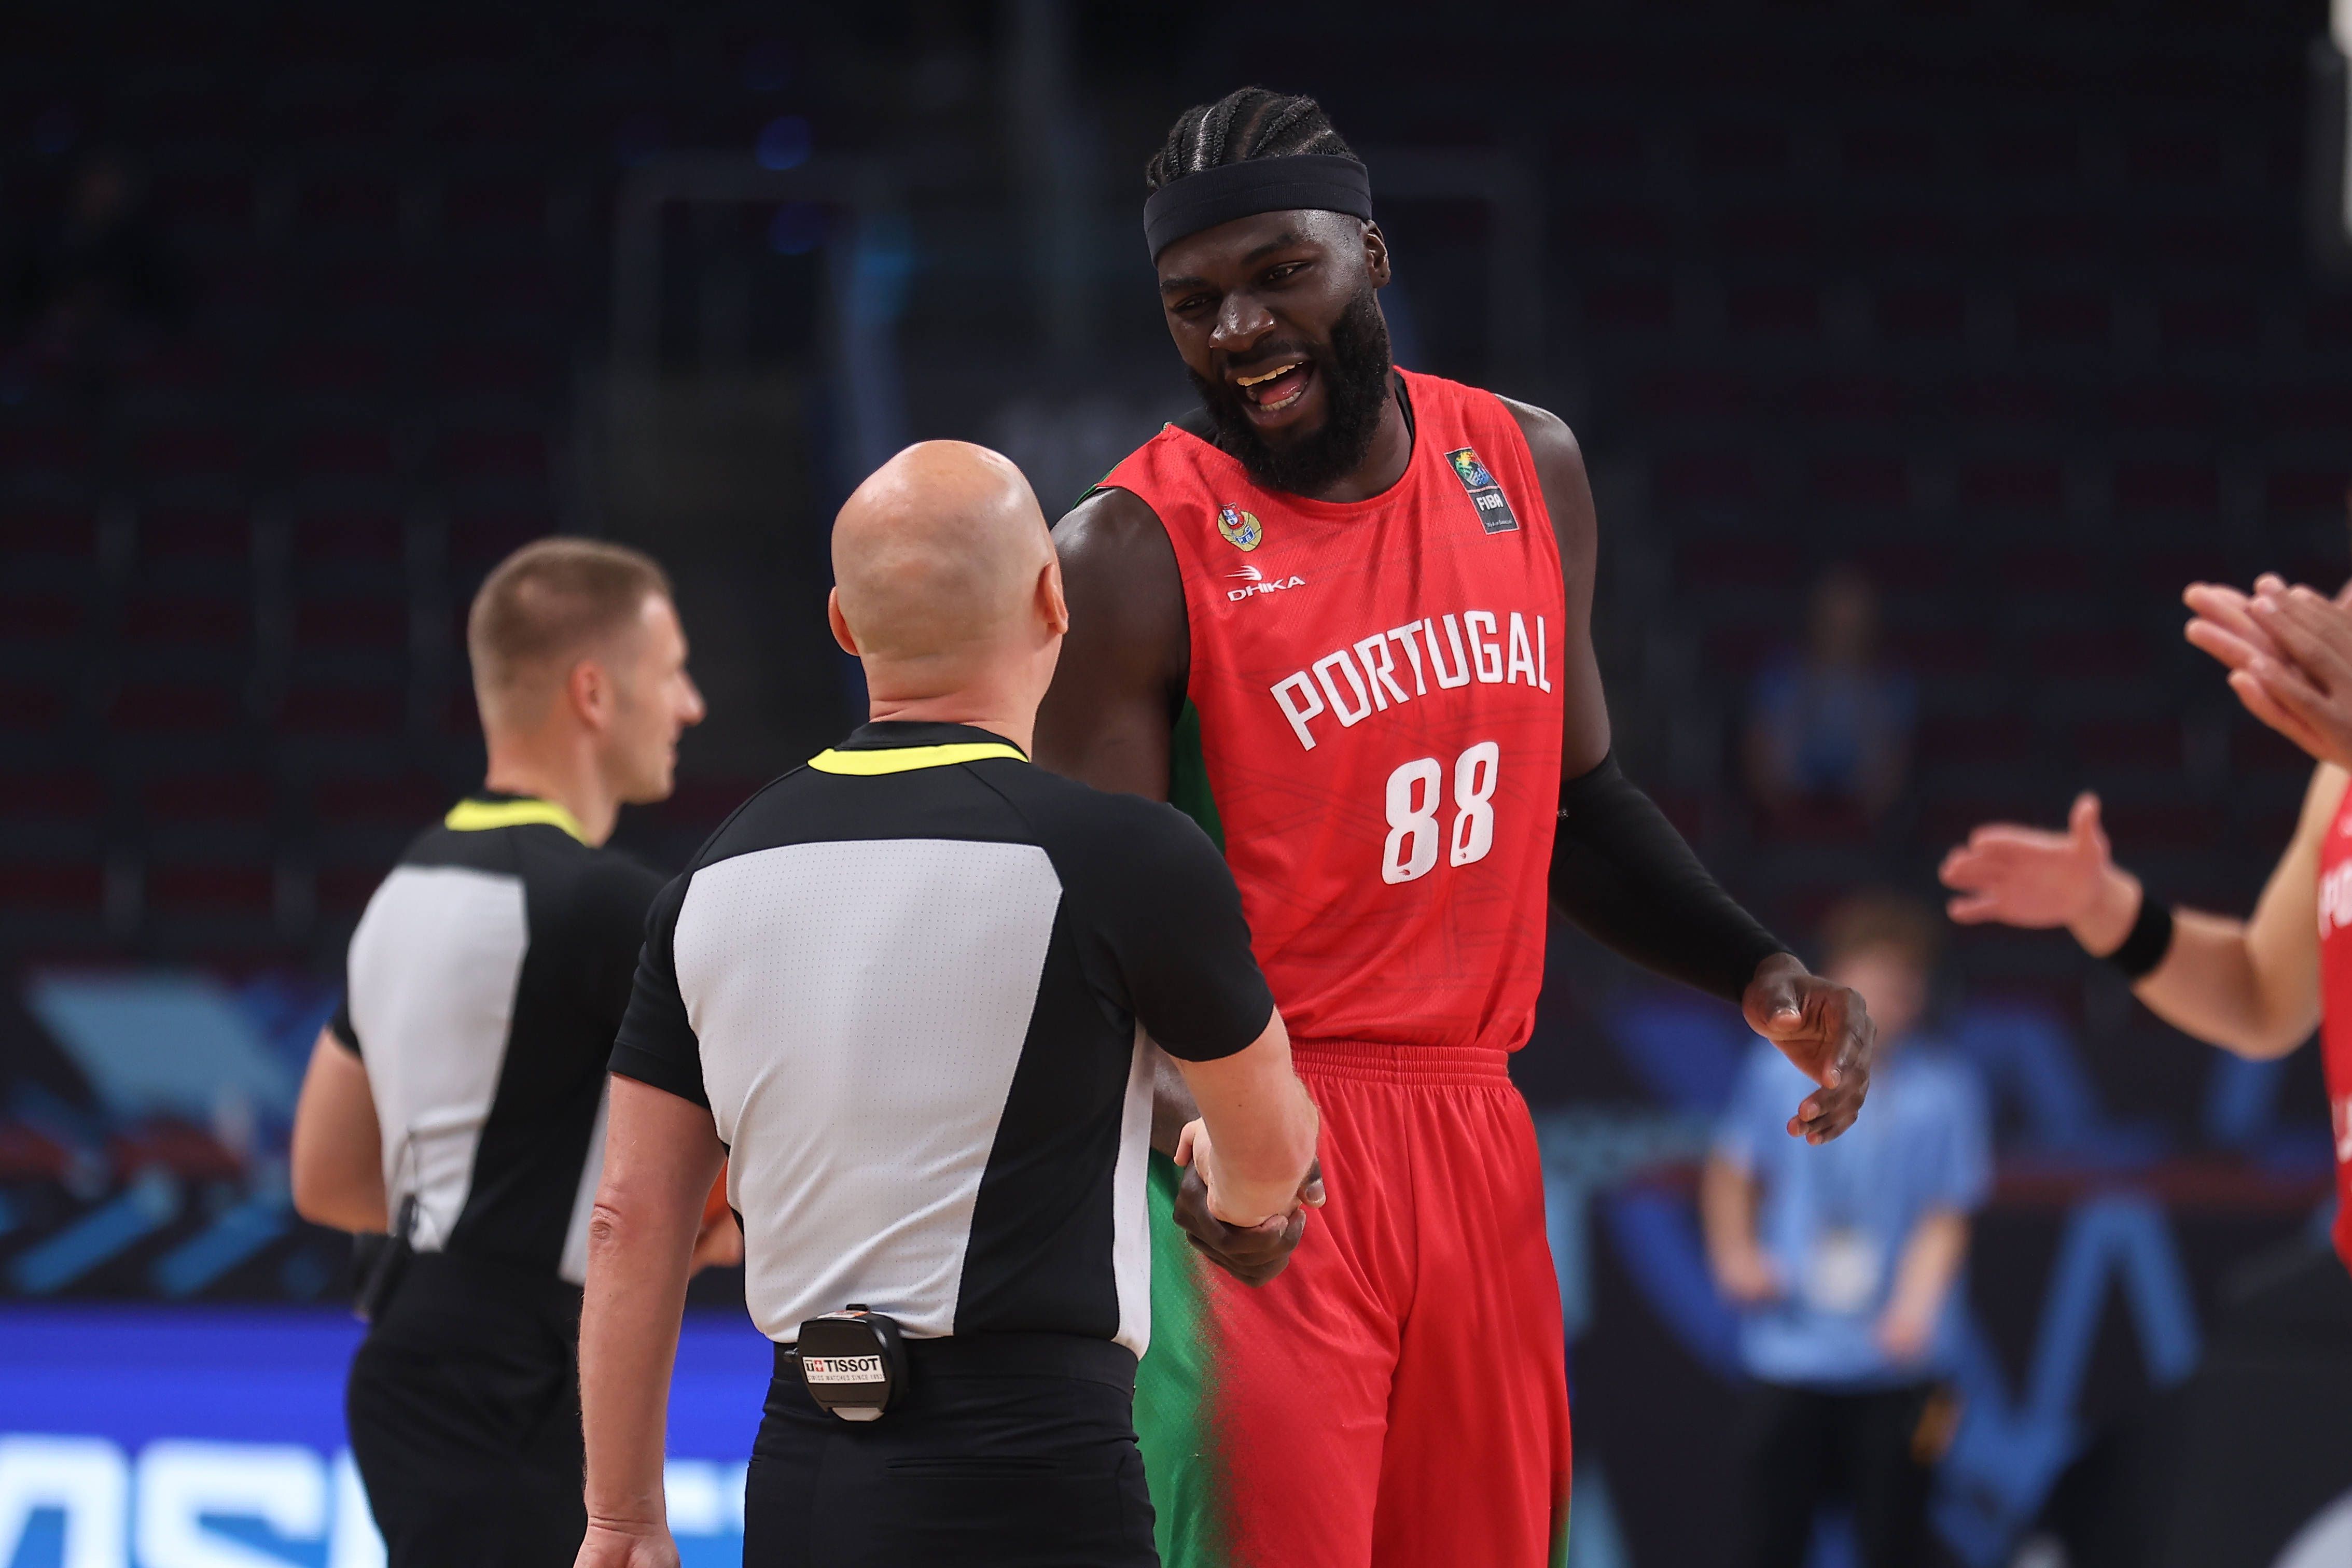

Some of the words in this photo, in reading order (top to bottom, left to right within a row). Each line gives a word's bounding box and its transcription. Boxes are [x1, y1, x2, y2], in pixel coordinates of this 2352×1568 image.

[1476, 493, 1504, 511] FIBA
[1227, 576, 1306, 601] DHIKA
[1269, 610, 1552, 751] PORTUGAL
[1382, 741, 1500, 885] 88
[824, 1358, 878, 1373] TISSOT
